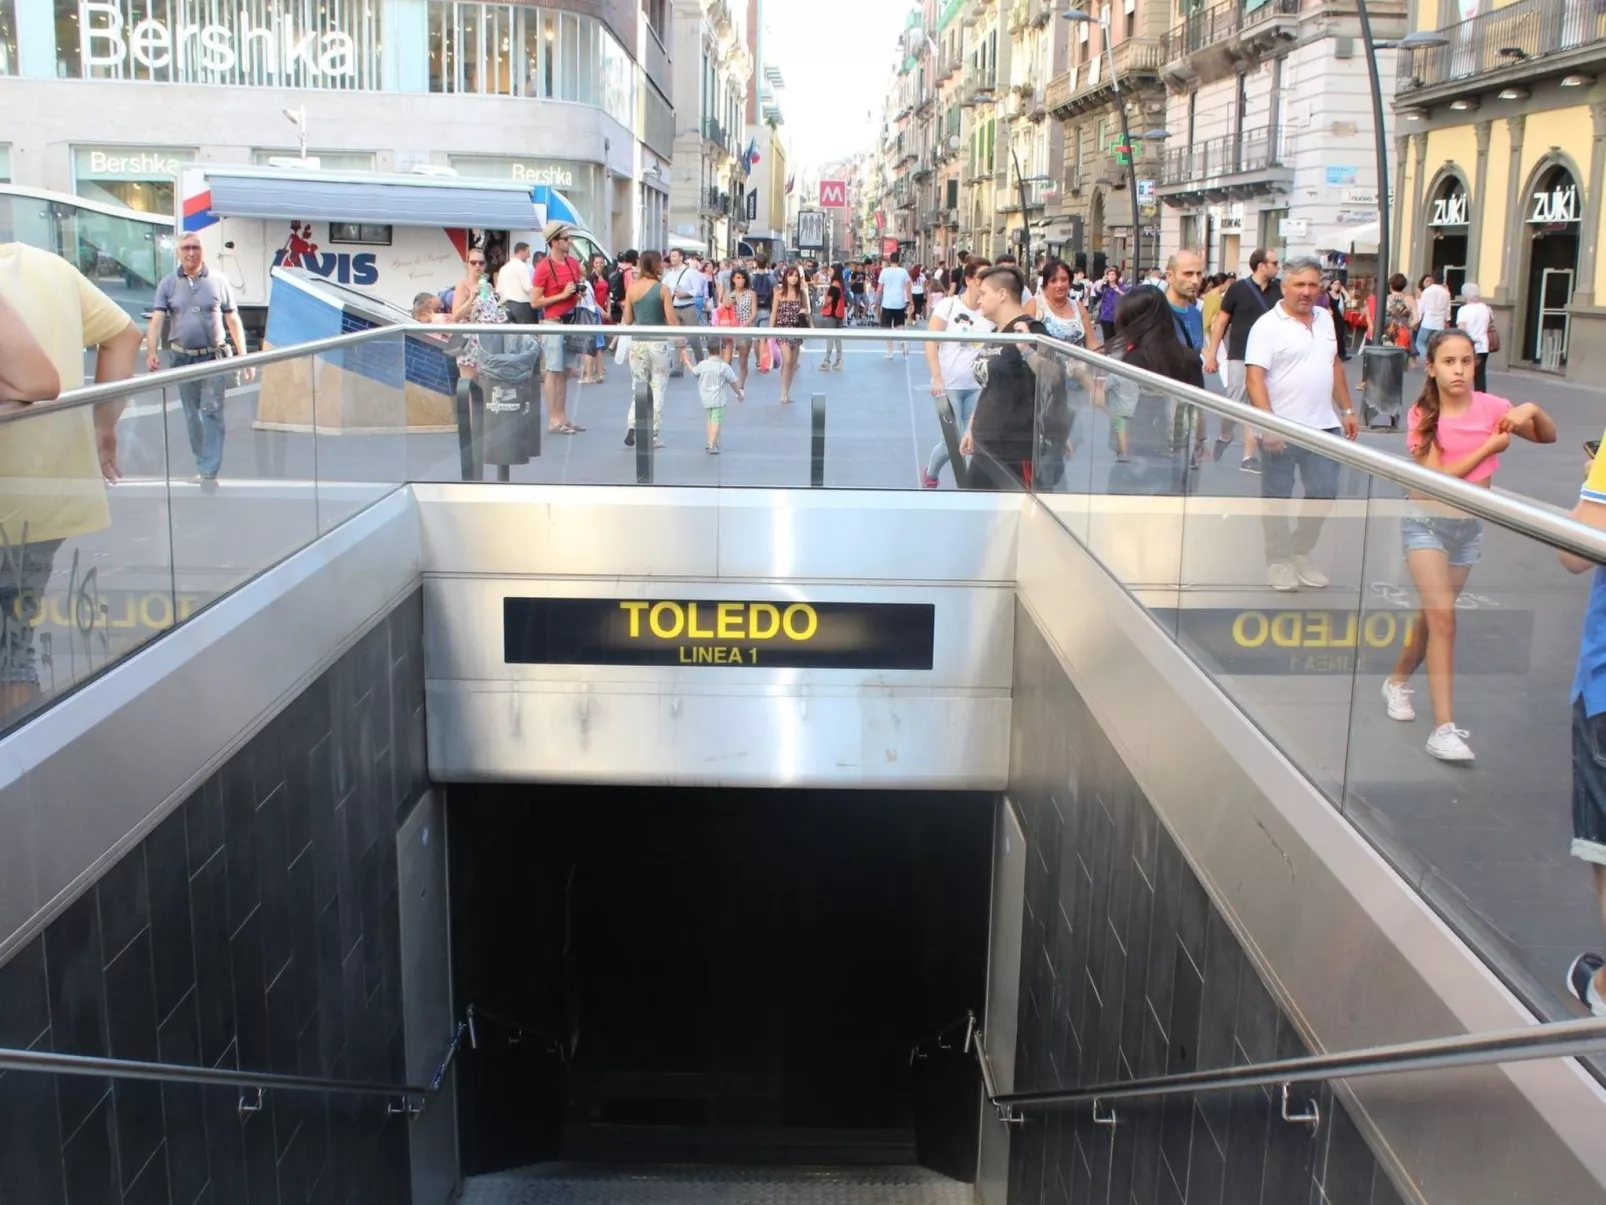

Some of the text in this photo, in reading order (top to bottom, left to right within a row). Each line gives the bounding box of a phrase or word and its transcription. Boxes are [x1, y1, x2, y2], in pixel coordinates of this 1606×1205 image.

[78, 1, 356, 77] Bershka
[90, 151, 180, 175] Bershka
[512, 163, 573, 186] Bershka
[822, 185, 843, 203] M
[620, 601, 818, 640] TOLEDO
[679, 646, 758, 664] LINEA 1
